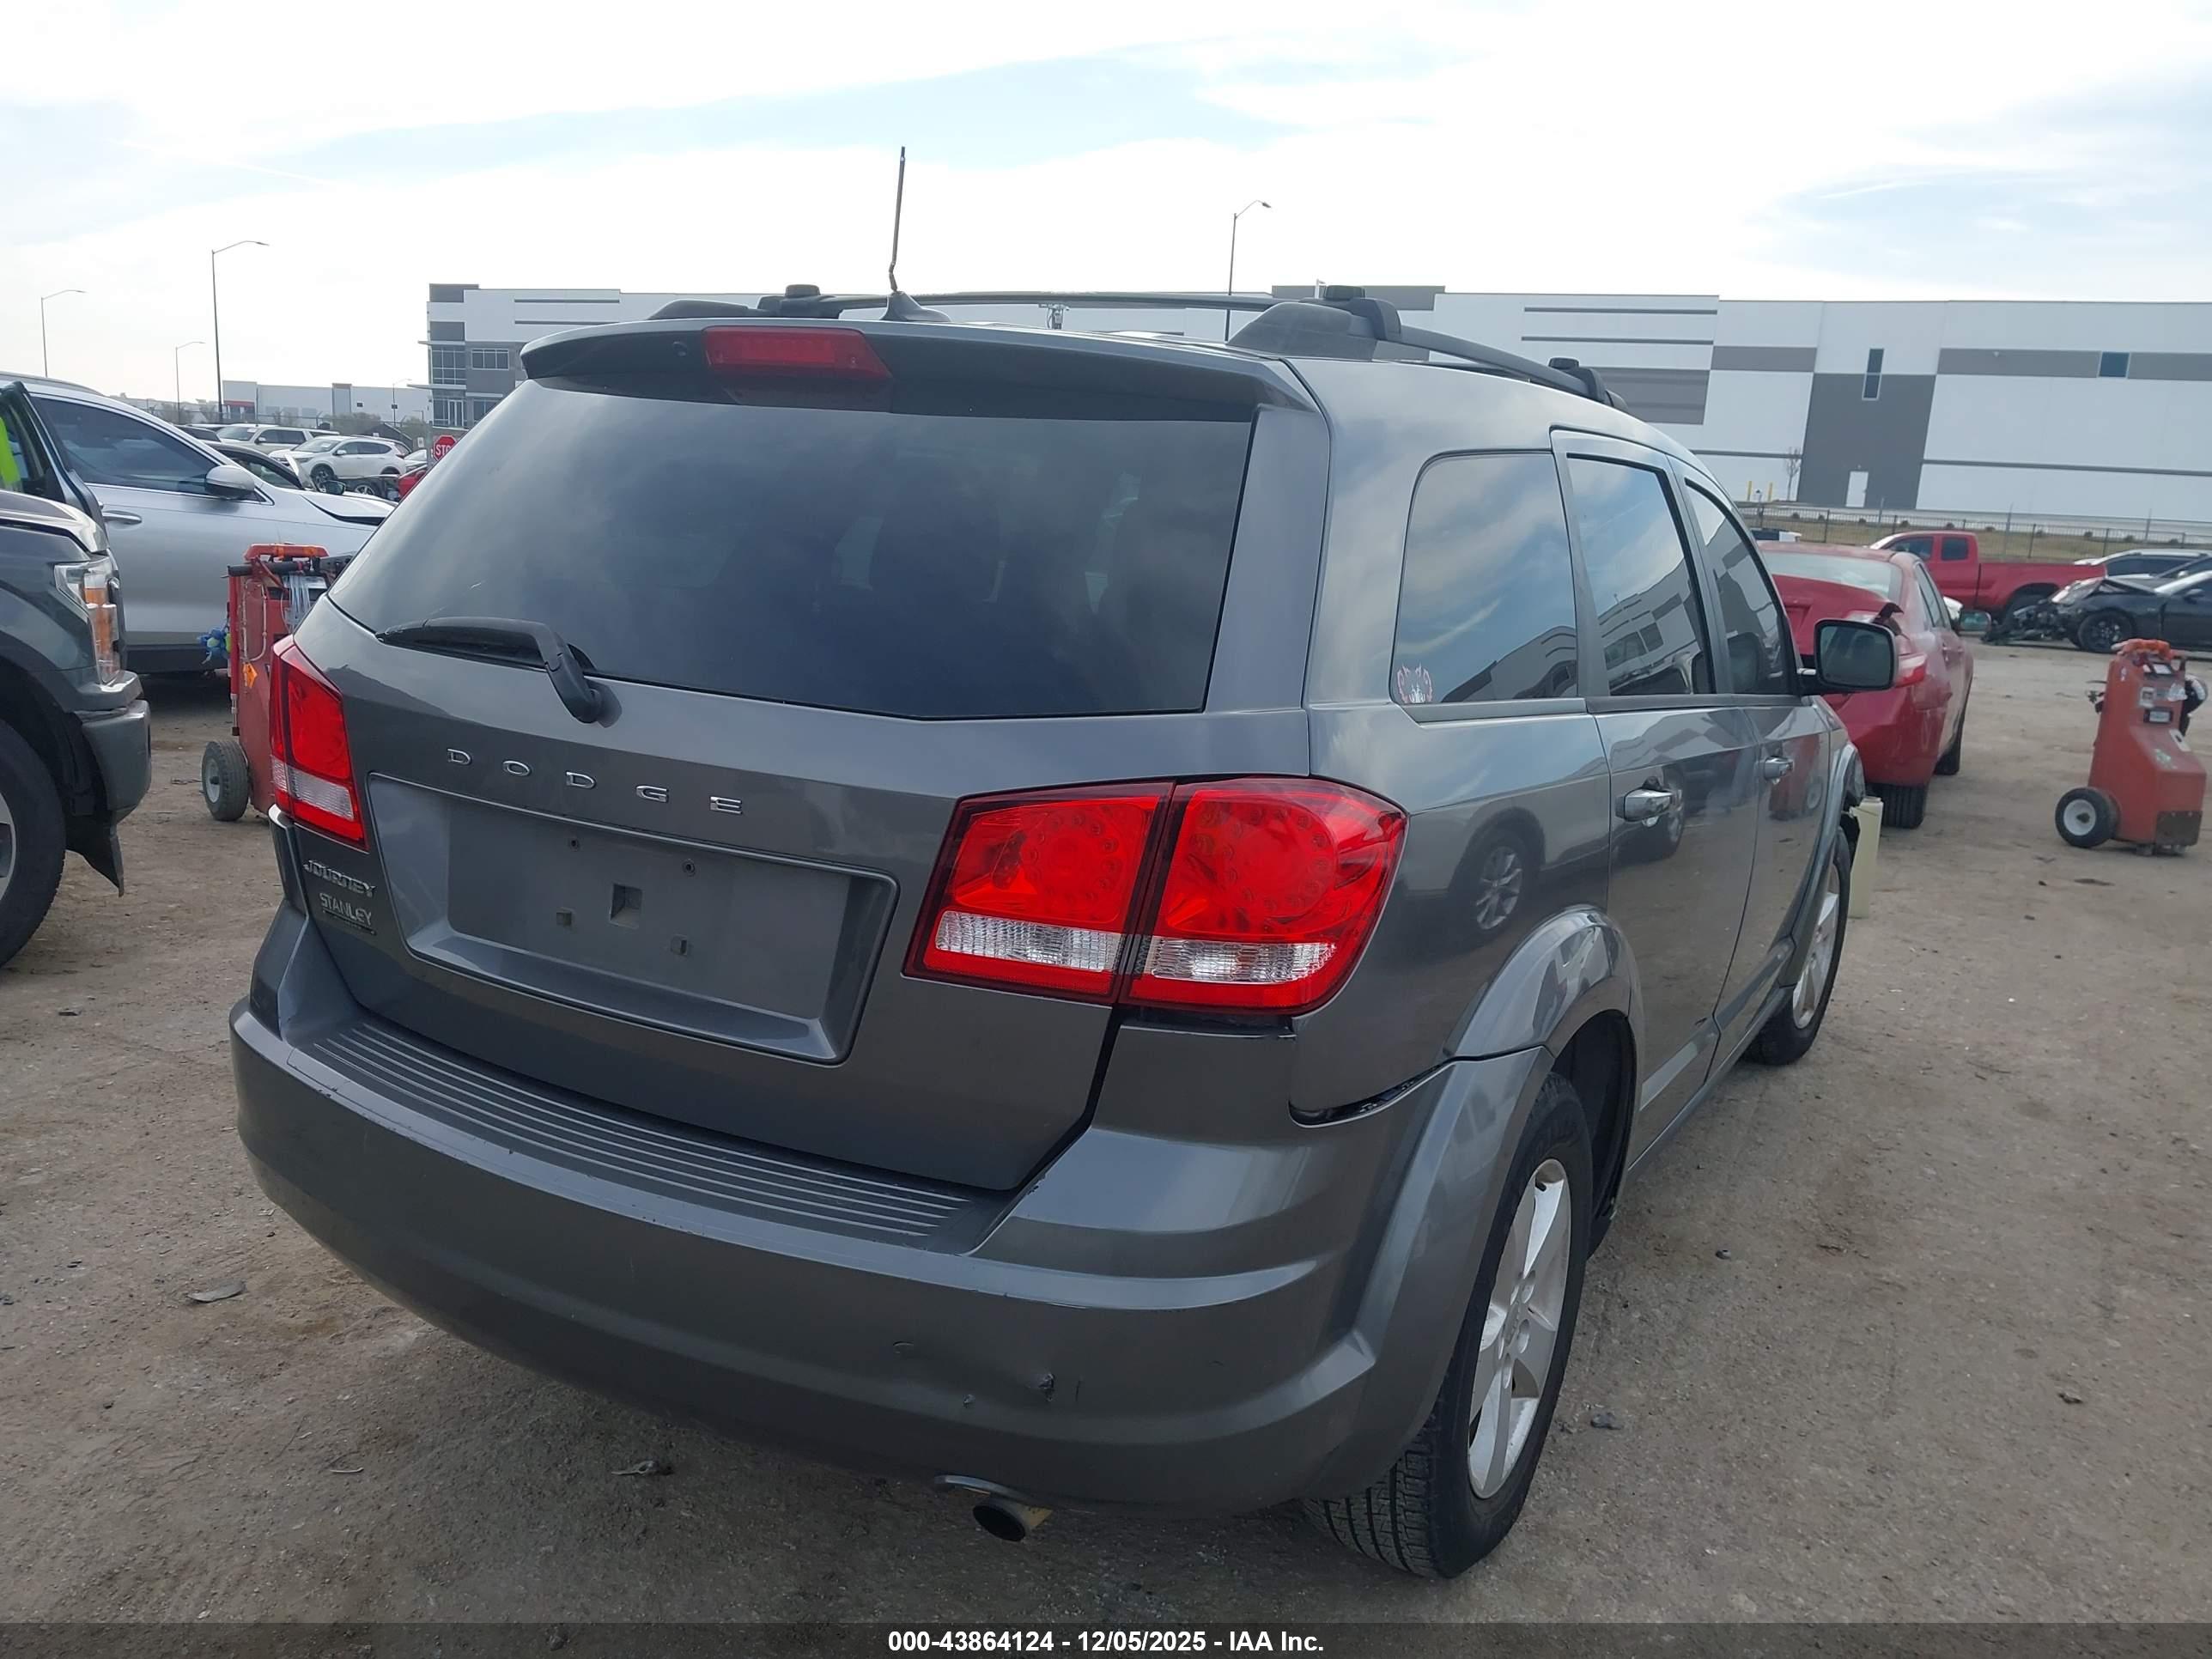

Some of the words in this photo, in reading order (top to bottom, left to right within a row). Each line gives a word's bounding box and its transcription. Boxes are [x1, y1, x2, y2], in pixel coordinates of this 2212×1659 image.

[447, 748, 743, 815] DODGE
[303, 860, 376, 897] JOURNEY
[319, 892, 372, 926] STANLEY
